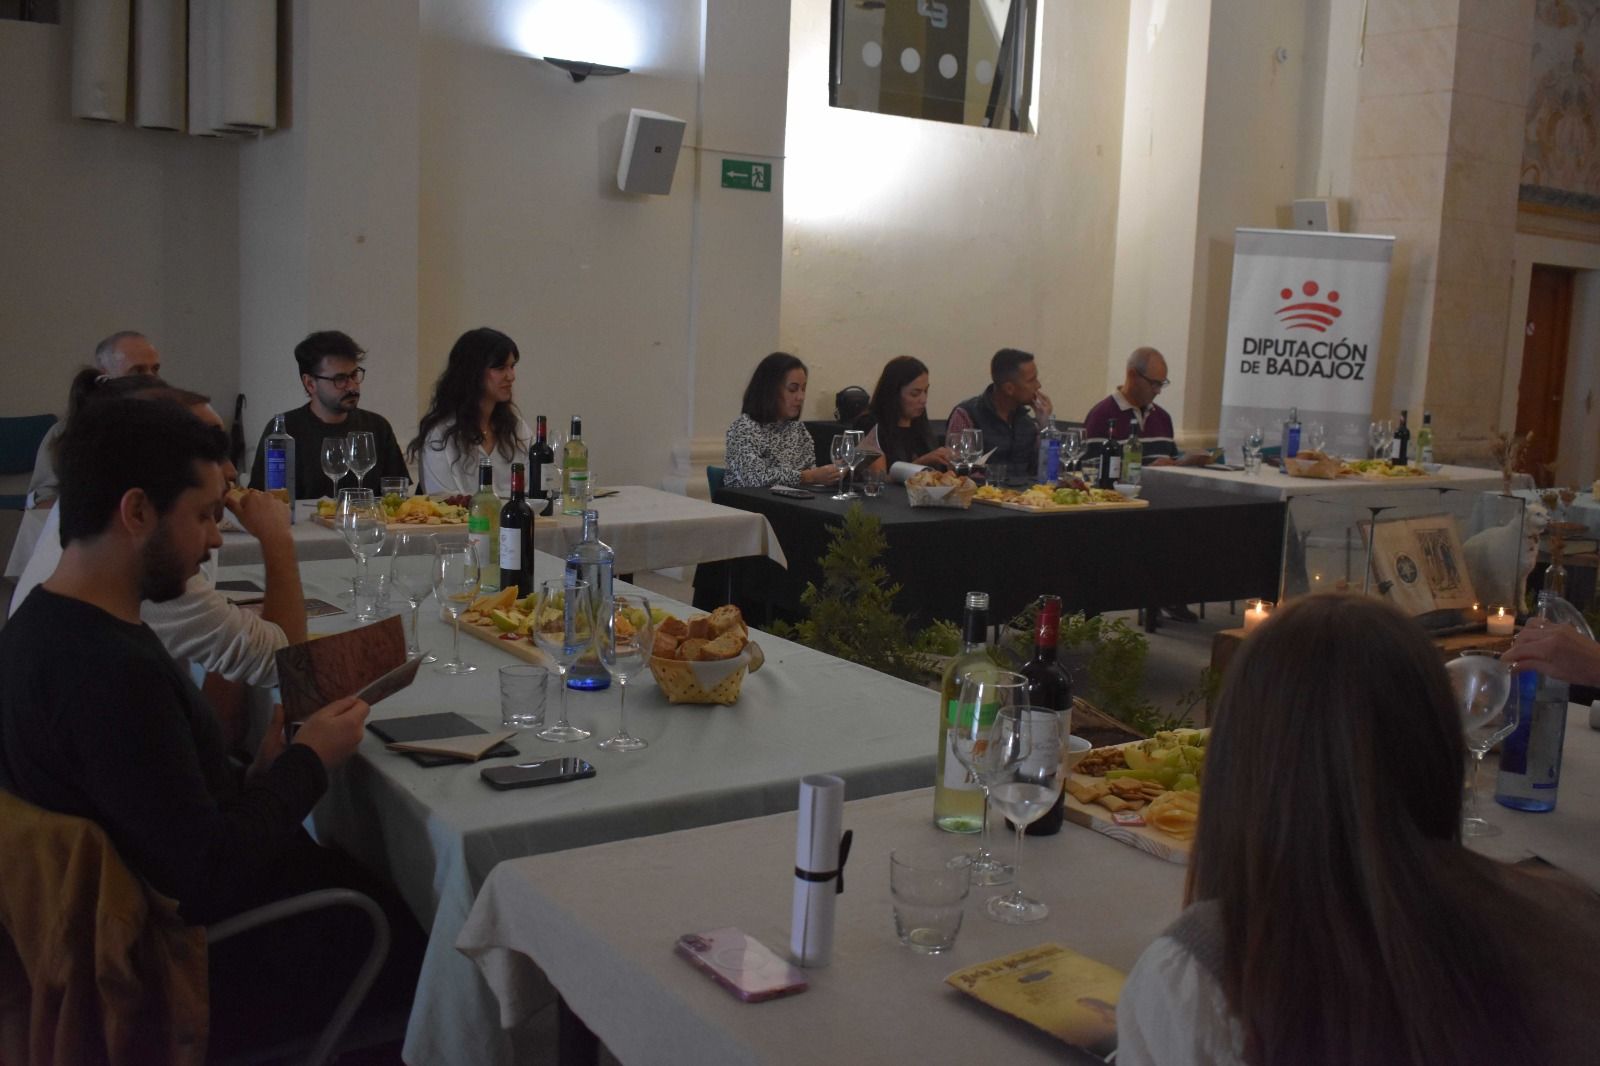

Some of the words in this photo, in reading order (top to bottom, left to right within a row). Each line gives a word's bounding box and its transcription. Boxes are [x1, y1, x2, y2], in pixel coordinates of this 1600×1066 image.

[1242, 337, 1368, 362] DIPUTACIÓN
[1240, 360, 1260, 375] DE
[1266, 358, 1366, 381] BADAJOZ
